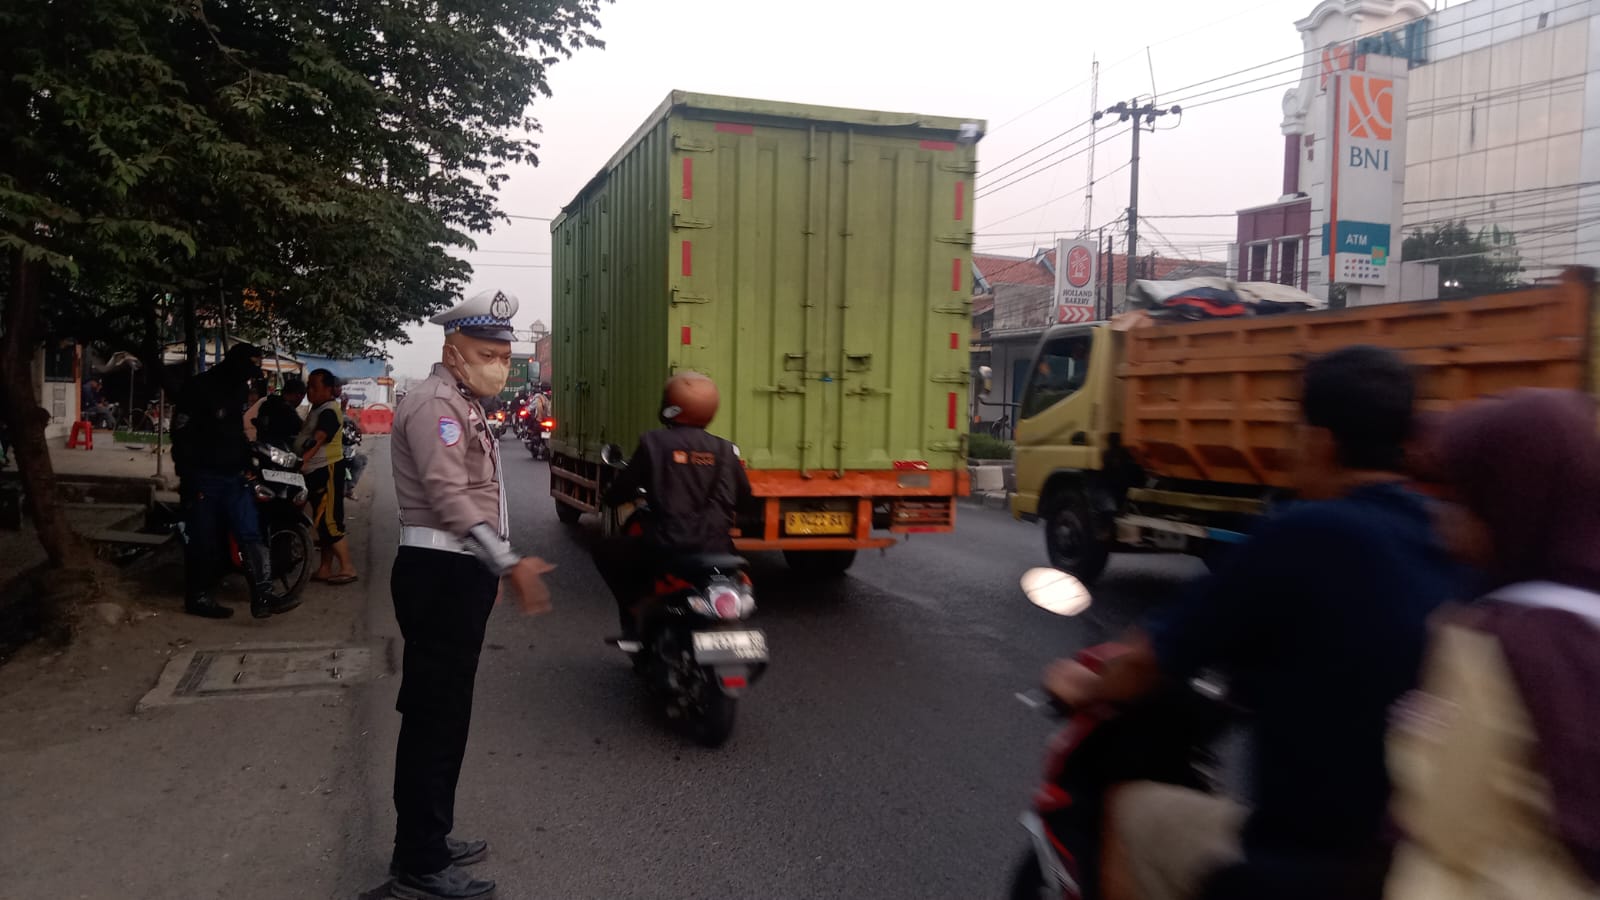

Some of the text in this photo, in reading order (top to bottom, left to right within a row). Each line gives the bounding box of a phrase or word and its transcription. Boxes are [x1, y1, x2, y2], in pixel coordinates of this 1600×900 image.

[1349, 145, 1389, 171] BNI
[1345, 233, 1368, 246] ATM
[1062, 289, 1093, 297] HOLLAND
[1065, 297, 1090, 305] BAKERY
